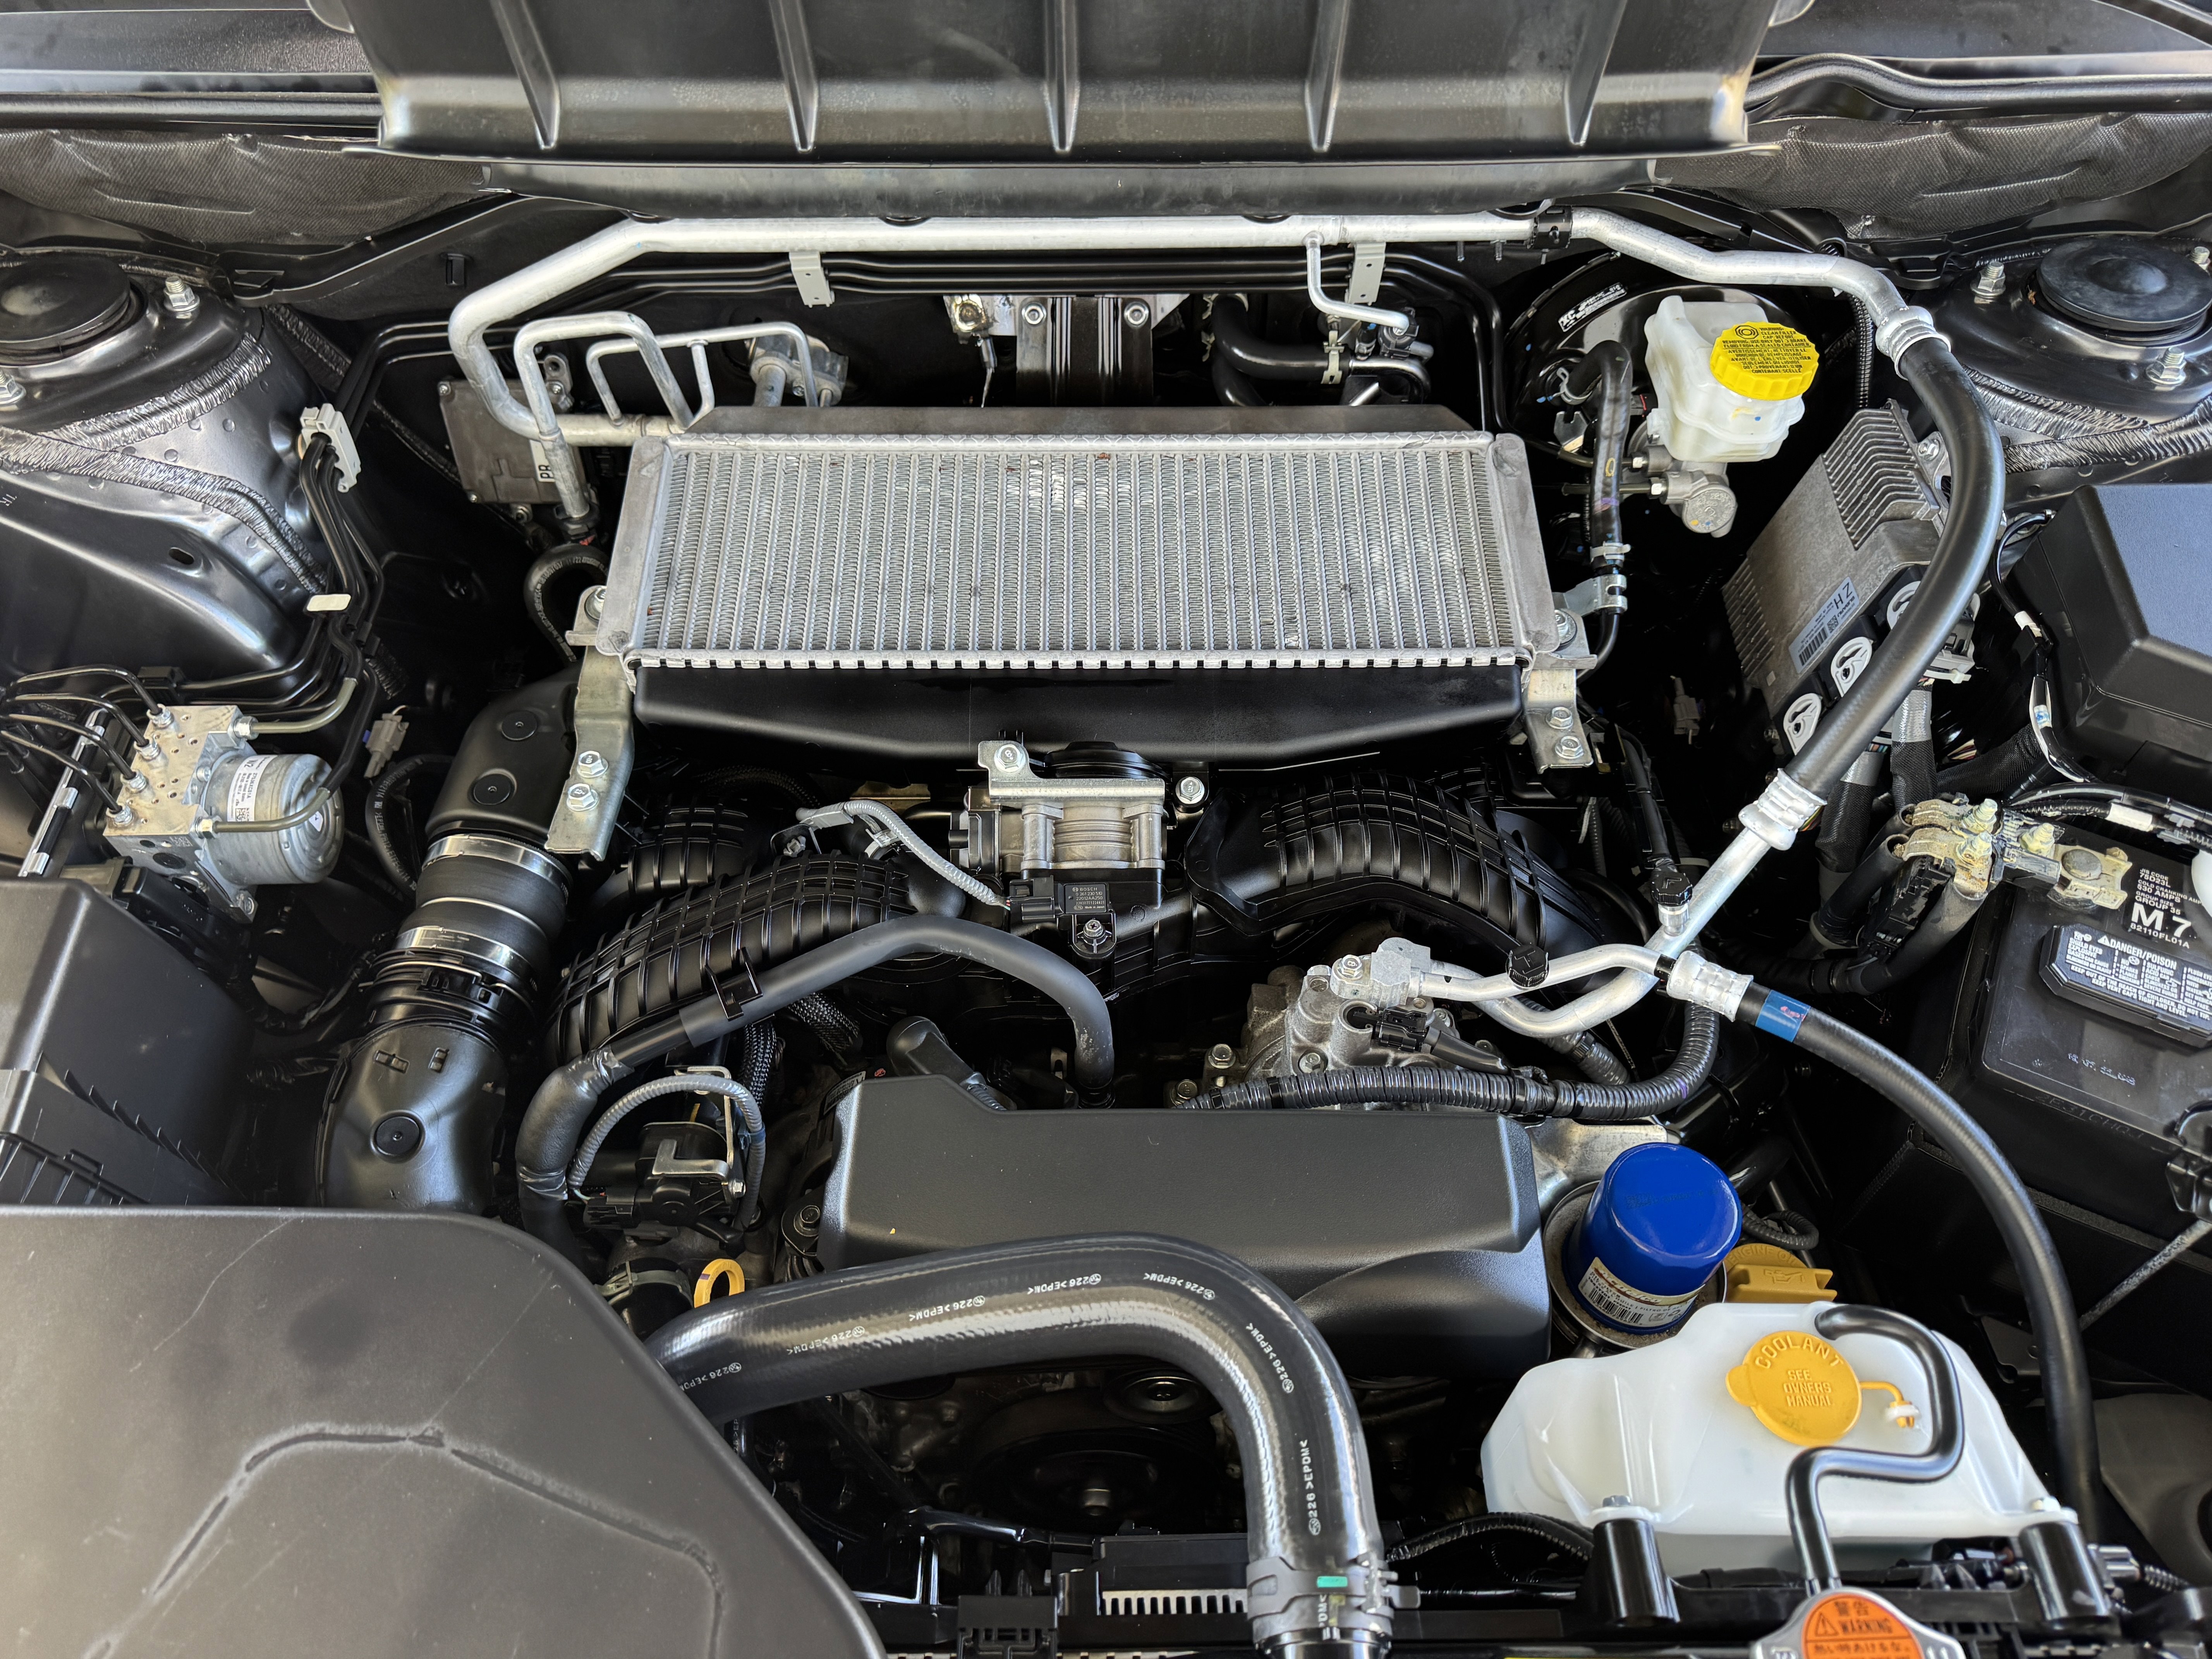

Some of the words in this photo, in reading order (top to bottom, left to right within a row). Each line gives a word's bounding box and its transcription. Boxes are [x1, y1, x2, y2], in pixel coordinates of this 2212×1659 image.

[1837, 595, 1855, 618] SUBARU
[2139, 872, 2171, 888] 75D23L
[2150, 871, 2169, 881] CODE
[2135, 890, 2159, 902] GROUP
[2159, 899, 2174, 907] SIZE
[2137, 879, 2154, 889] COLD
[2155, 885, 2187, 900] CRANKING
[2188, 896, 2203, 905] AMP
[2137, 884, 2152, 894] 530
[2154, 890, 2181, 903] AMPS
[2135, 895, 2168, 911] GROUP
[2170, 907, 2181, 915] 35
[2130, 922, 2190, 950] 82110FL01A
[2068, 943, 2097, 958] EXPLOSIVE
[2069, 937, 2088, 949] SHIELD
[2088, 945, 2103, 955] EYES
[2109, 938, 2177, 970] DANGER/POISON
[2120, 958, 2130, 967] NO
[2120, 964, 2138, 975] SPARKS
[2146, 962, 2174, 977] SULFURIC
[2119, 969, 2138, 979] FLAMES
[2145, 967, 2159, 977] ACID
[2159, 973, 2169, 981] CAN
[2145, 973, 2160, 983] CAUSE
[2070, 964, 2085, 974] KEEP
[2085, 970, 2097, 979] OUT
[2106, 977, 2118, 986] THE
[2119, 982, 2137, 993] REACH
[2186, 1007, 2198, 1016] NOT
[2091, 978, 2106, 988] KEEP
[2107, 984, 2121, 993] VENT
[2121, 989, 2137, 999] CAPS
[2138, 994, 2155, 1005] TIGHT
[2155, 1001, 2168, 1010] AND
[2184, 997, 2197, 1006] HELP
[1728, 1244, 1775, 1266] ENGINE
[1069, 1276, 1089, 1288] 226
[1143, 1272, 1184, 1286] >EPDM<
[1027, 1280, 1068, 1295] >EPDM<
[1185, 1281, 1204, 1295] 226
[953, 1298, 973, 1310] 226
[908, 1305, 950, 1322] >EPDM<
[830, 1328, 852, 1343] 226
[1246, 1322, 1274, 1360] >EPDM<
[786, 1337, 829, 1356] >EPDM<
[1755, 1335, 1845, 1369] COOLANT
[709, 1365, 730, 1381] 226
[1273, 1359, 1290, 1381] 226
[1787, 1369, 1812, 1381] SEE
[1783, 1381, 1832, 1394] OWNERS
[1786, 1395, 1833, 1408] MANUAL
[1299, 1439, 1314, 1491] >EPDM<
[1306, 1492, 1319, 1518] 226
[1839, 1618, 1893, 1634] WARNING
